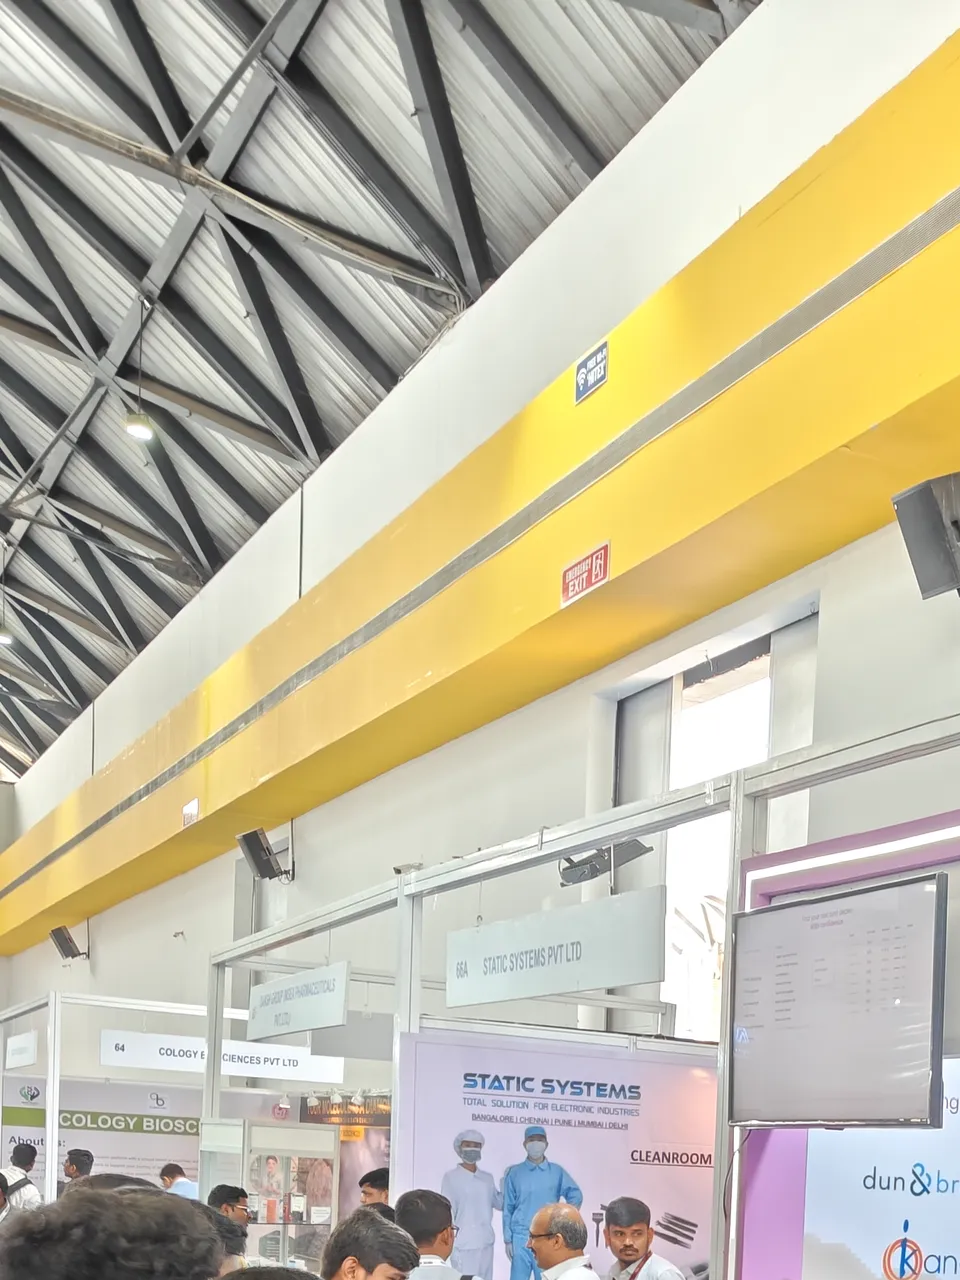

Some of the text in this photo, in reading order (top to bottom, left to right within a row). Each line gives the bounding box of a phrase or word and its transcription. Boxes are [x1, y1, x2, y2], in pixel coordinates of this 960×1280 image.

[568, 572, 588, 597] EXIT
[456, 941, 582, 979] 66A STATIC SYSTEMS PVT LTD
[114, 1043, 125, 1052] 64
[159, 1047, 198, 1059] COLOGY
[263, 1056, 280, 1066] PVT
[282, 1058, 298, 1067] LTD
[463, 1073, 641, 1100] STATIC SYSTEMS
[463, 1097, 640, 1117] TOTAL SOLUTION FOR ELECTRONIC INDUSTRIES
[59, 1113, 200, 1134] COLOGY BIOSC
[472, 1114, 629, 1130] BANGALORE CHENNAI PUNE MUMBAI DELHI
[631, 1150, 712, 1166] CLEANROOM
